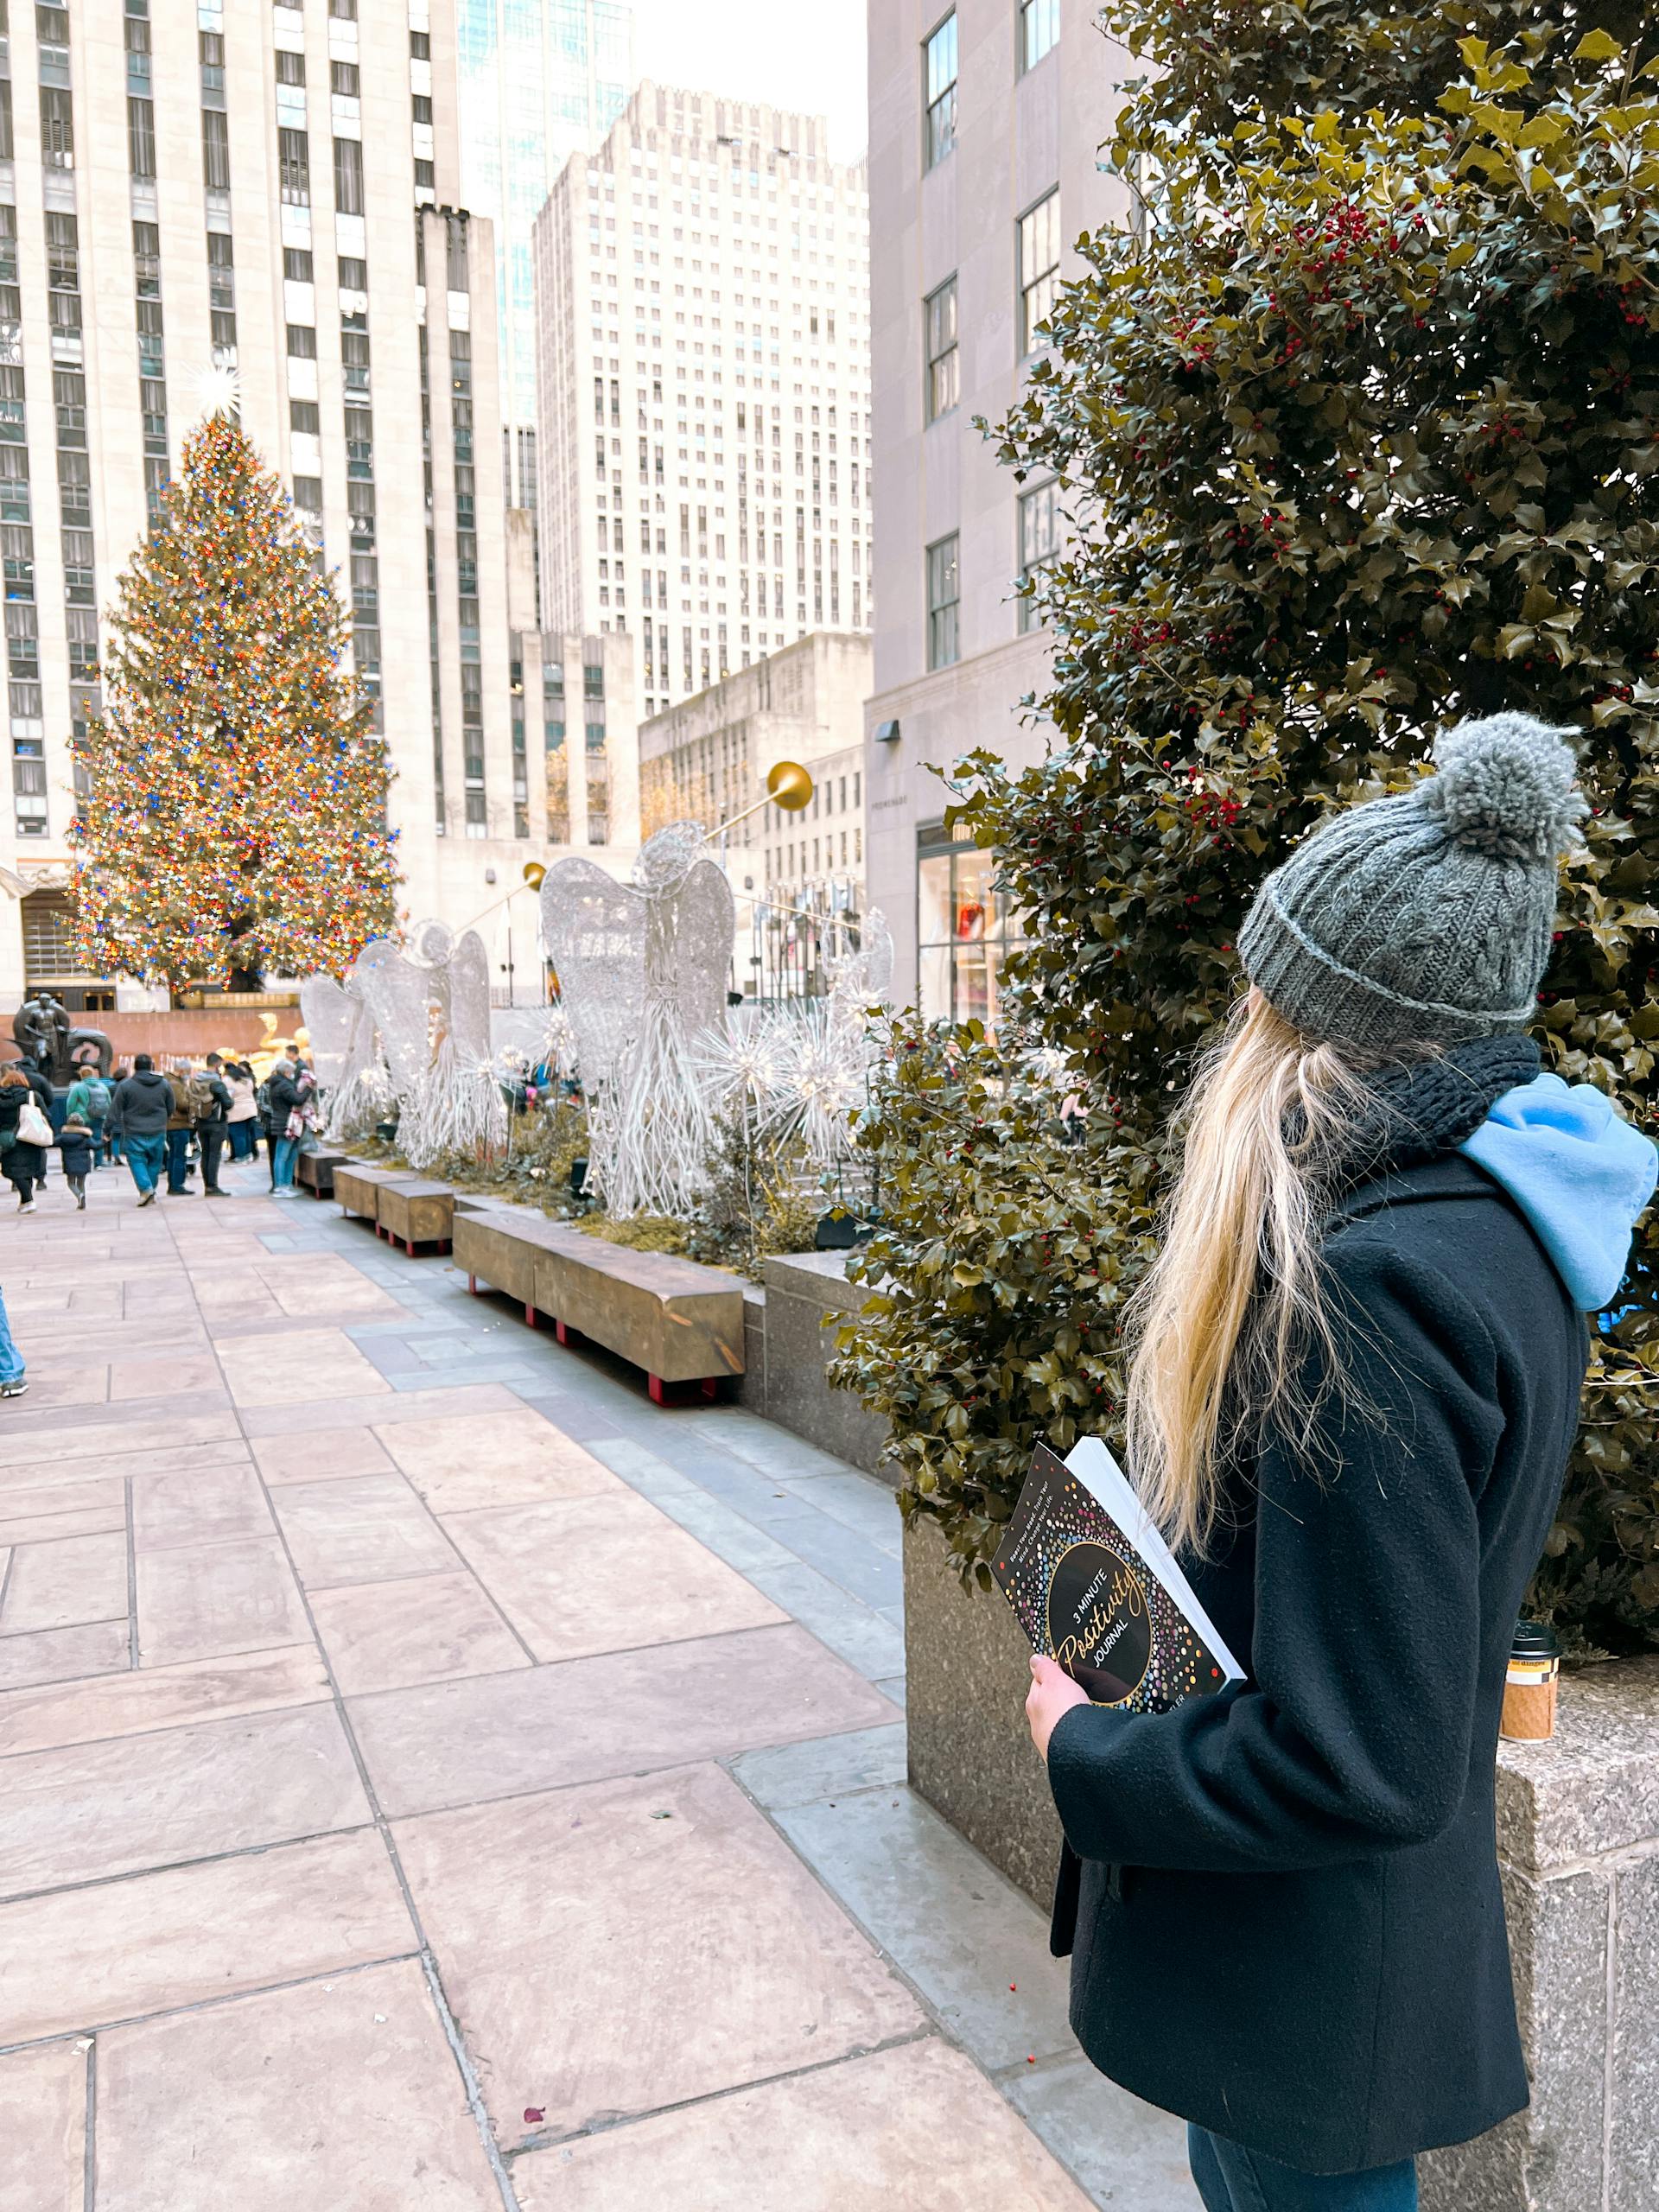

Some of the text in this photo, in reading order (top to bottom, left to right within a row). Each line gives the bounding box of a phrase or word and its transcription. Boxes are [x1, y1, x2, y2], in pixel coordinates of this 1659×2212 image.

[1009, 1480, 1049, 1563] Boost Your Mood. Train Your
[1018, 1495, 1054, 1564] Mind. Change Your Life.
[1057, 1568, 1141, 1679] Positivity
[1072, 1567, 1109, 1624] 3 MINUTE
[1093, 1618, 1129, 1669] JOURNAL
